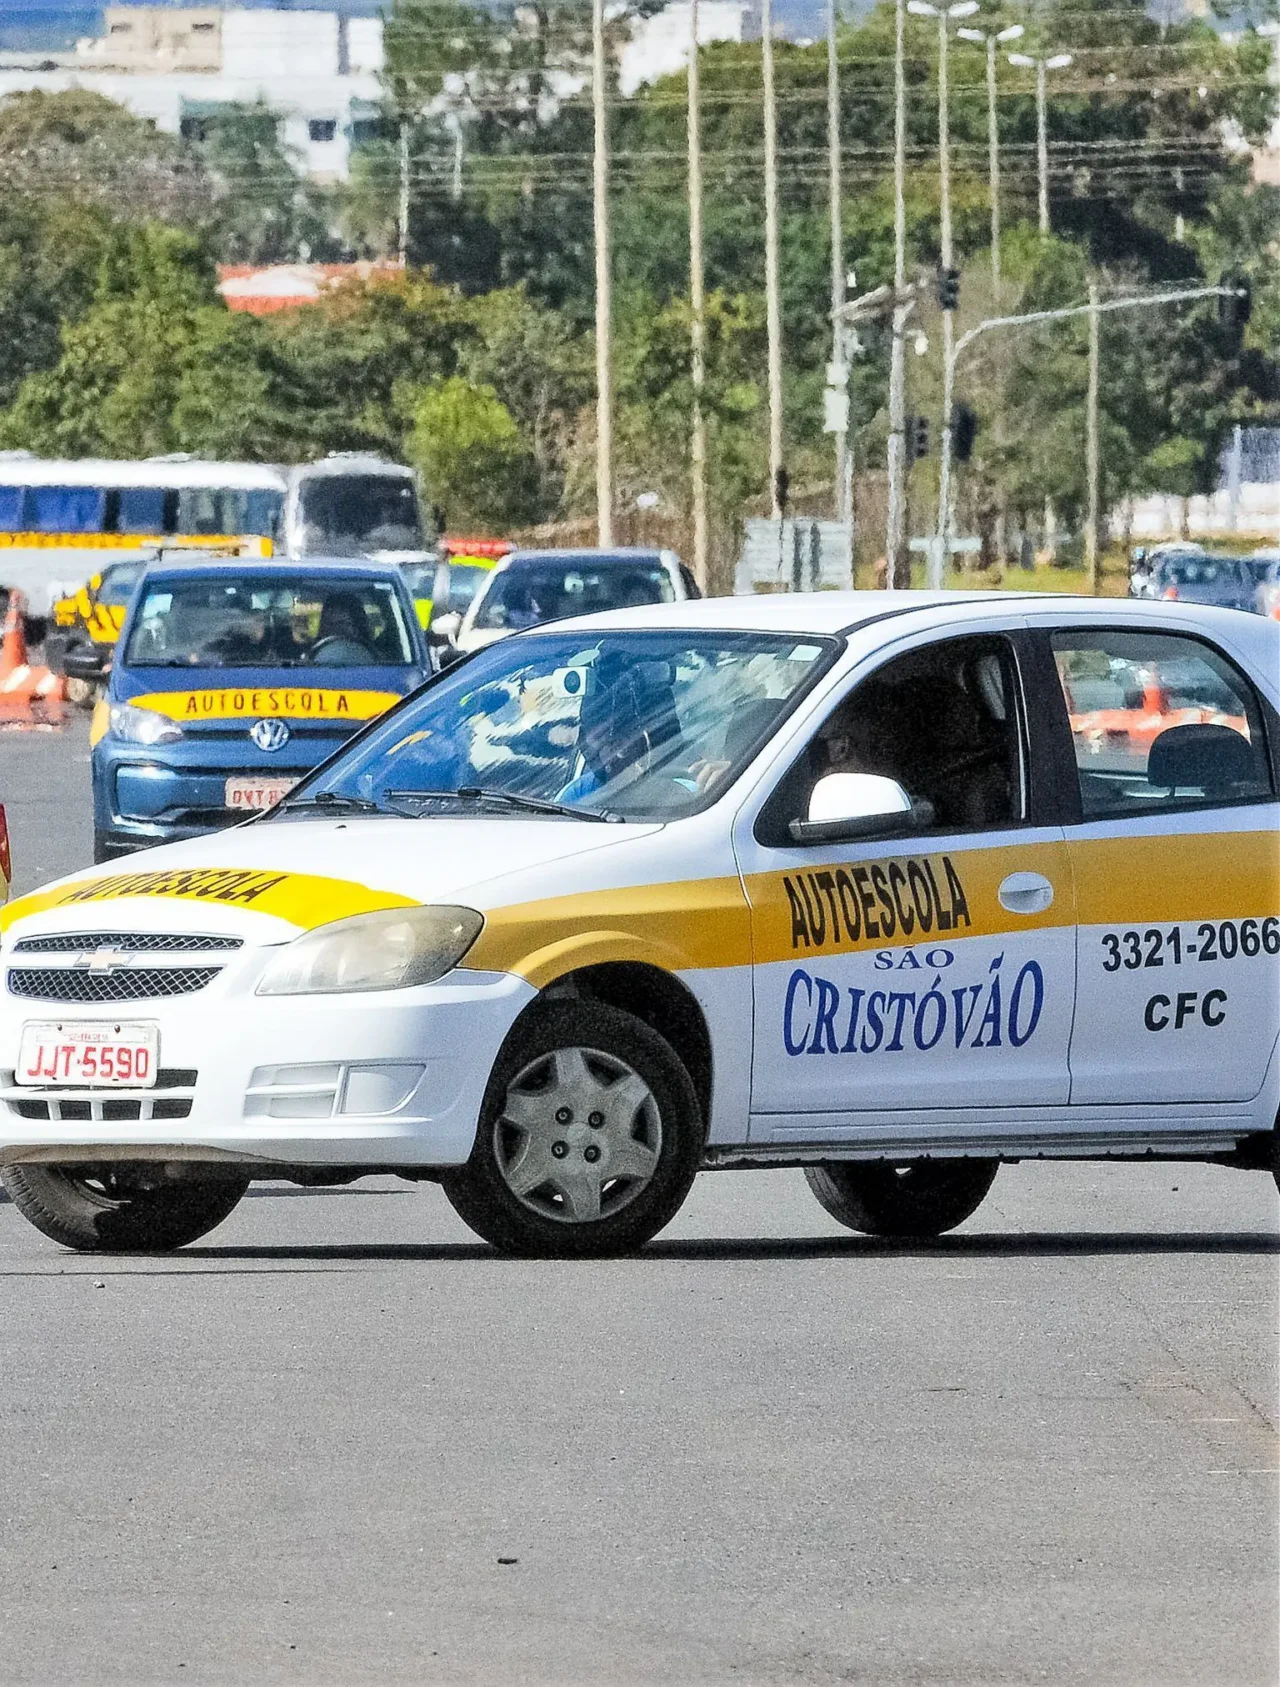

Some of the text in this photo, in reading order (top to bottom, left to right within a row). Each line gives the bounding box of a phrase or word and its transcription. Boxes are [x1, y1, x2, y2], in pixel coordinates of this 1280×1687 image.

[185, 691, 349, 714] AUTOESCOLA
[57, 869, 289, 904] AUTOESCOLA
[783, 856, 971, 948] AUTOESCOLA
[874, 945, 955, 970] SÃO
[1101, 916, 1280, 972] 3321-2066
[783, 951, 1044, 1056] CRISTÓVÃO
[1144, 989, 1228, 1032] CFC
